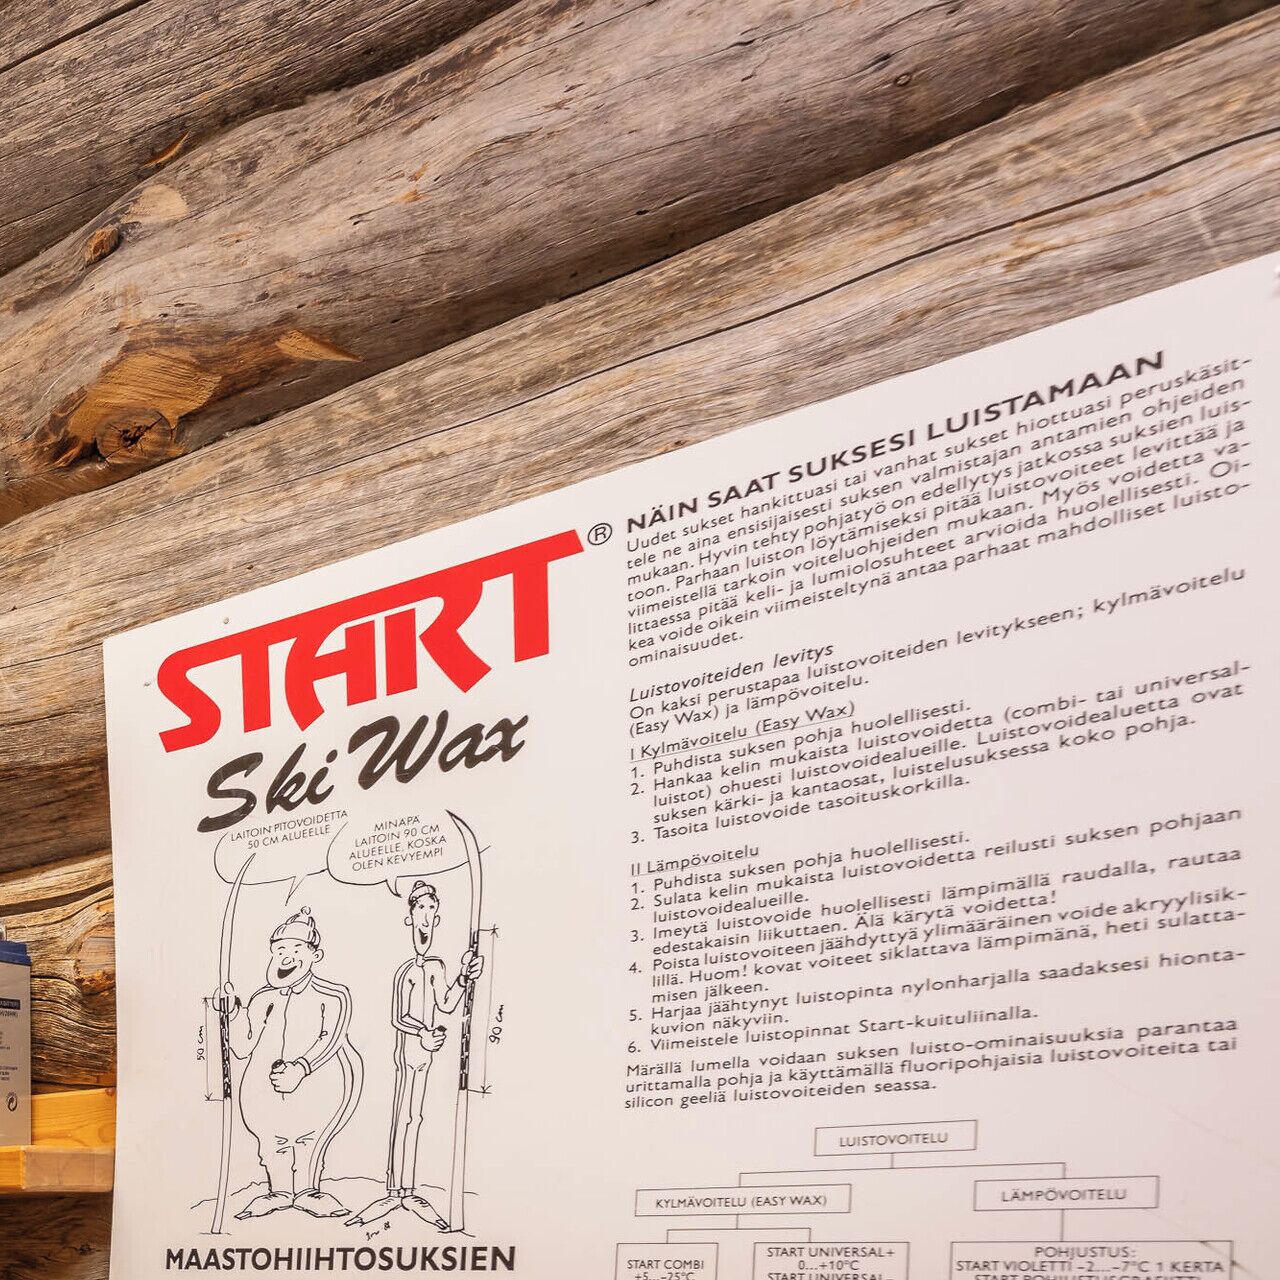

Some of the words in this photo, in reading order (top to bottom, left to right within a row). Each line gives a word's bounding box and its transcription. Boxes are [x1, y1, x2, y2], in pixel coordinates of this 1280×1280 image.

[626, 495, 698, 534] NÄIN
[706, 470, 781, 509] SAAT
[787, 427, 915, 484] SUKSESI
[926, 349, 1164, 442] LUISTAMAAN
[157, 528, 584, 753] START
[627, 630, 744, 667] ominaisuudet.
[628, 704, 654, 720] On
[660, 692, 701, 713] kaksi
[707, 672, 800, 707] perustapaa
[806, 637, 948, 679] luistovoiteiden
[956, 605, 1083, 645] levitykseen;
[1092, 566, 1245, 615] kylmävoitelu
[628, 660, 764, 703] Luistovoiteiden
[772, 643, 834, 669] levitys
[628, 718, 670, 739] (Easy
[672, 703, 719, 726] Wax)
[724, 702, 740, 720] ja
[745, 673, 869, 711] lämpövoitelu.
[630, 765, 645, 779] 1.
[652, 751, 723, 775] Puhdista
[727, 738, 786, 760] suksen
[792, 725, 843, 751] pohja
[850, 698, 971, 734] huolellisesti.
[639, 725, 747, 760] Kylmävoitelu
[754, 715, 800, 737] (Easy
[803, 699, 855, 721] Wax)
[652, 783, 712, 807] luistot)
[718, 770, 782, 795] ohuesti
[790, 737, 967, 781] luistovoidealueille.
[976, 696, 1179, 746] Luistovoidealuetta
[1190, 683, 1244, 704] ovat
[197, 742, 342, 833] Ski
[347, 709, 529, 791] Wax
[630, 829, 645, 844] 3.
[651, 821, 709, 840] Tasoita
[715, 800, 811, 829] luistovoide
[816, 772, 970, 811] tasoituskorkilla.
[231, 825, 272, 841] LAITOIN
[274, 810, 348, 832] PITOVOIDETTA
[248, 839, 259, 849] 50
[262, 837, 279, 847] CM
[281, 825, 330, 842] ALUEELLE
[355, 832, 400, 847] LAITOIN
[404, 829, 417, 838] 90
[421, 825, 439, 834] CM
[408, 835, 447, 849] KOSKA
[352, 858, 383, 871] OLEN
[387, 847, 443, 865] KEVYEMPI
[630, 881, 645, 895] 1.
[653, 871, 723, 891] Puhdista
[728, 861, 786, 880] suksen
[792, 850, 843, 874] pohja
[849, 830, 970, 860] huolellisesti.
[646, 843, 759, 874] Lämpövoitelu
[651, 932, 750, 956] edestakaisin
[757, 921, 848, 942] liikuttaen.
[853, 913, 885, 930] Älä
[892, 903, 955, 925] kärytä
[962, 889, 1056, 915] voidetta!
[652, 890, 809, 924] luistovoidealueille.
[650, 989, 698, 1004] misen
[703, 982, 769, 1002] jälkeen.
[626, 1039, 641, 1054] 6.
[649, 1031, 739, 1051] Viimeistele
[744, 1023, 851, 1043] luistopinnat
[857, 1004, 1038, 1033] Start-kuituliinalla.
[649, 1020, 705, 1036] kuvion
[711, 1011, 789, 1031] näkyviin.
[625, 1060, 682, 1077] Märällä
[689, 1054, 750, 1072] lumella
[757, 1050, 826, 1066] voidaan
[835, 1045, 899, 1061] suksen
[909, 1026, 1124, 1055] luisto-ominaisuuksia
[1136, 1019, 1238, 1042] parantaa
[623, 1094, 674, 1109] silicon
[679, 1089, 726, 1110] geeliä
[732, 1081, 866, 1102] luistovoiteiden
[872, 1079, 937, 1093] seassa.
[839, 1132, 949, 1147] LUISTOVOITELU
[655, 1194, 747, 1209] KYLMÄVOITELU
[750, 1194, 788, 1209] (EASY
[789, 1194, 828, 1208] WAX)
[1000, 1187, 1128, 1203] LÄMPÖVOITELU
[165, 1246, 516, 1272] MAASTOHIIHTOSUKSIEN
[627, 1259, 660, 1271] START
[662, 1259, 705, 1270] COMBI
[767, 1247, 806, 1259] START
[808, 1246, 895, 1258] UNIVERSAL+
[956, 1259, 998, 1274] START
[1000, 1260, 1072, 1274] VIOLETTI
[1155, 1260, 1165, 1273] 1
[1169, 1260, 1224, 1274] KERTA
[1034, 1245, 1138, 1260] POHJUSTUS:
